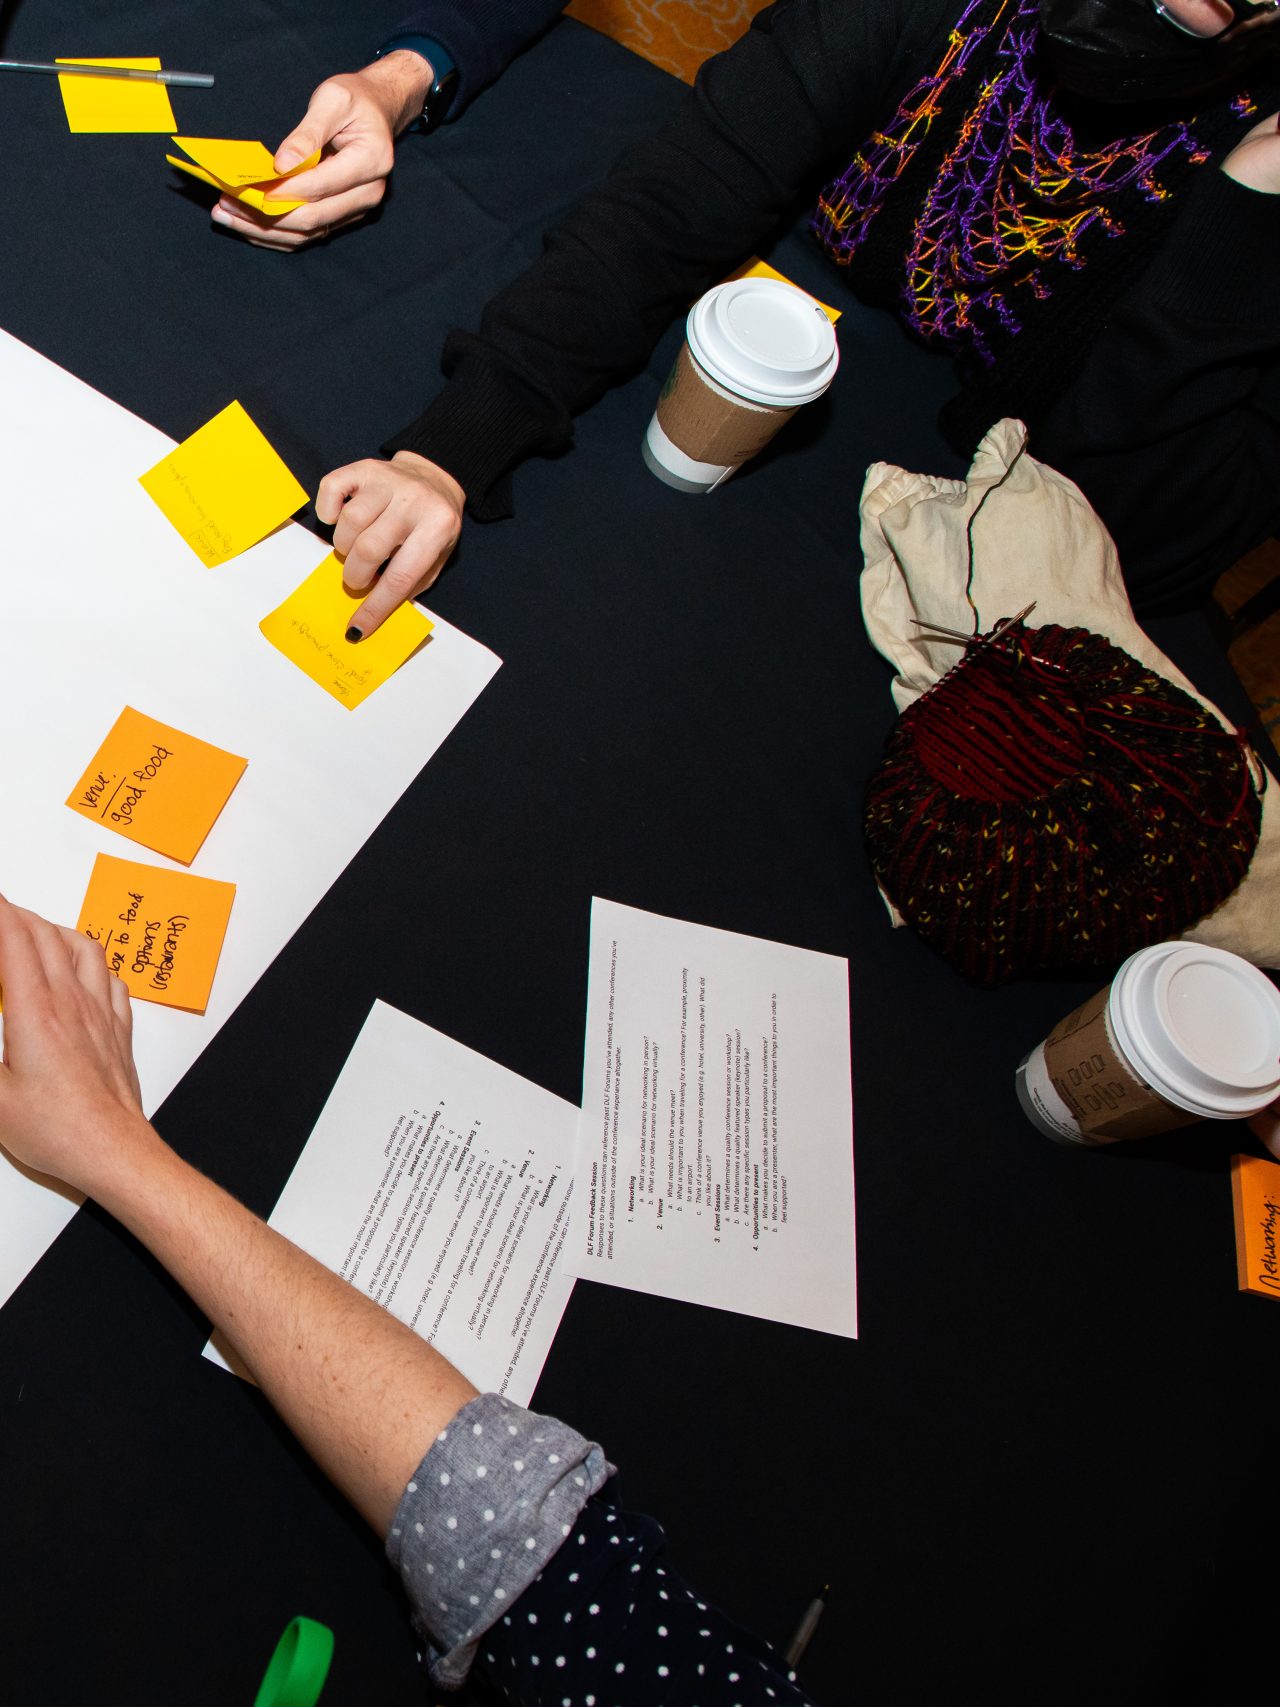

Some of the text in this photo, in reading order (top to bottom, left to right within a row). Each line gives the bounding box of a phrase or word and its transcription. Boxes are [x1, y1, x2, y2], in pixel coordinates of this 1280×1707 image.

[111, 744, 173, 825] good food
[119, 891, 145, 925] food
[113, 932, 130, 945] to
[419, 1109, 442, 1148] Opportunities
[464, 1128, 477, 1147] Event
[406, 1153, 421, 1178] present
[453, 1145, 470, 1173] Sessions
[517, 1159, 531, 1179] Venue
[537, 1173, 558, 1208] Networking
[752, 1163, 761, 1189] present
[627, 1174, 637, 1213] Networking
[656, 1197, 664, 1218] Venue
[713, 1183, 721, 1213] Sessions
[586, 1161, 598, 1256] DLF Forum Feedback Session
[713, 1212, 721, 1232] Event
[752, 1196, 761, 1240] Opportunities
